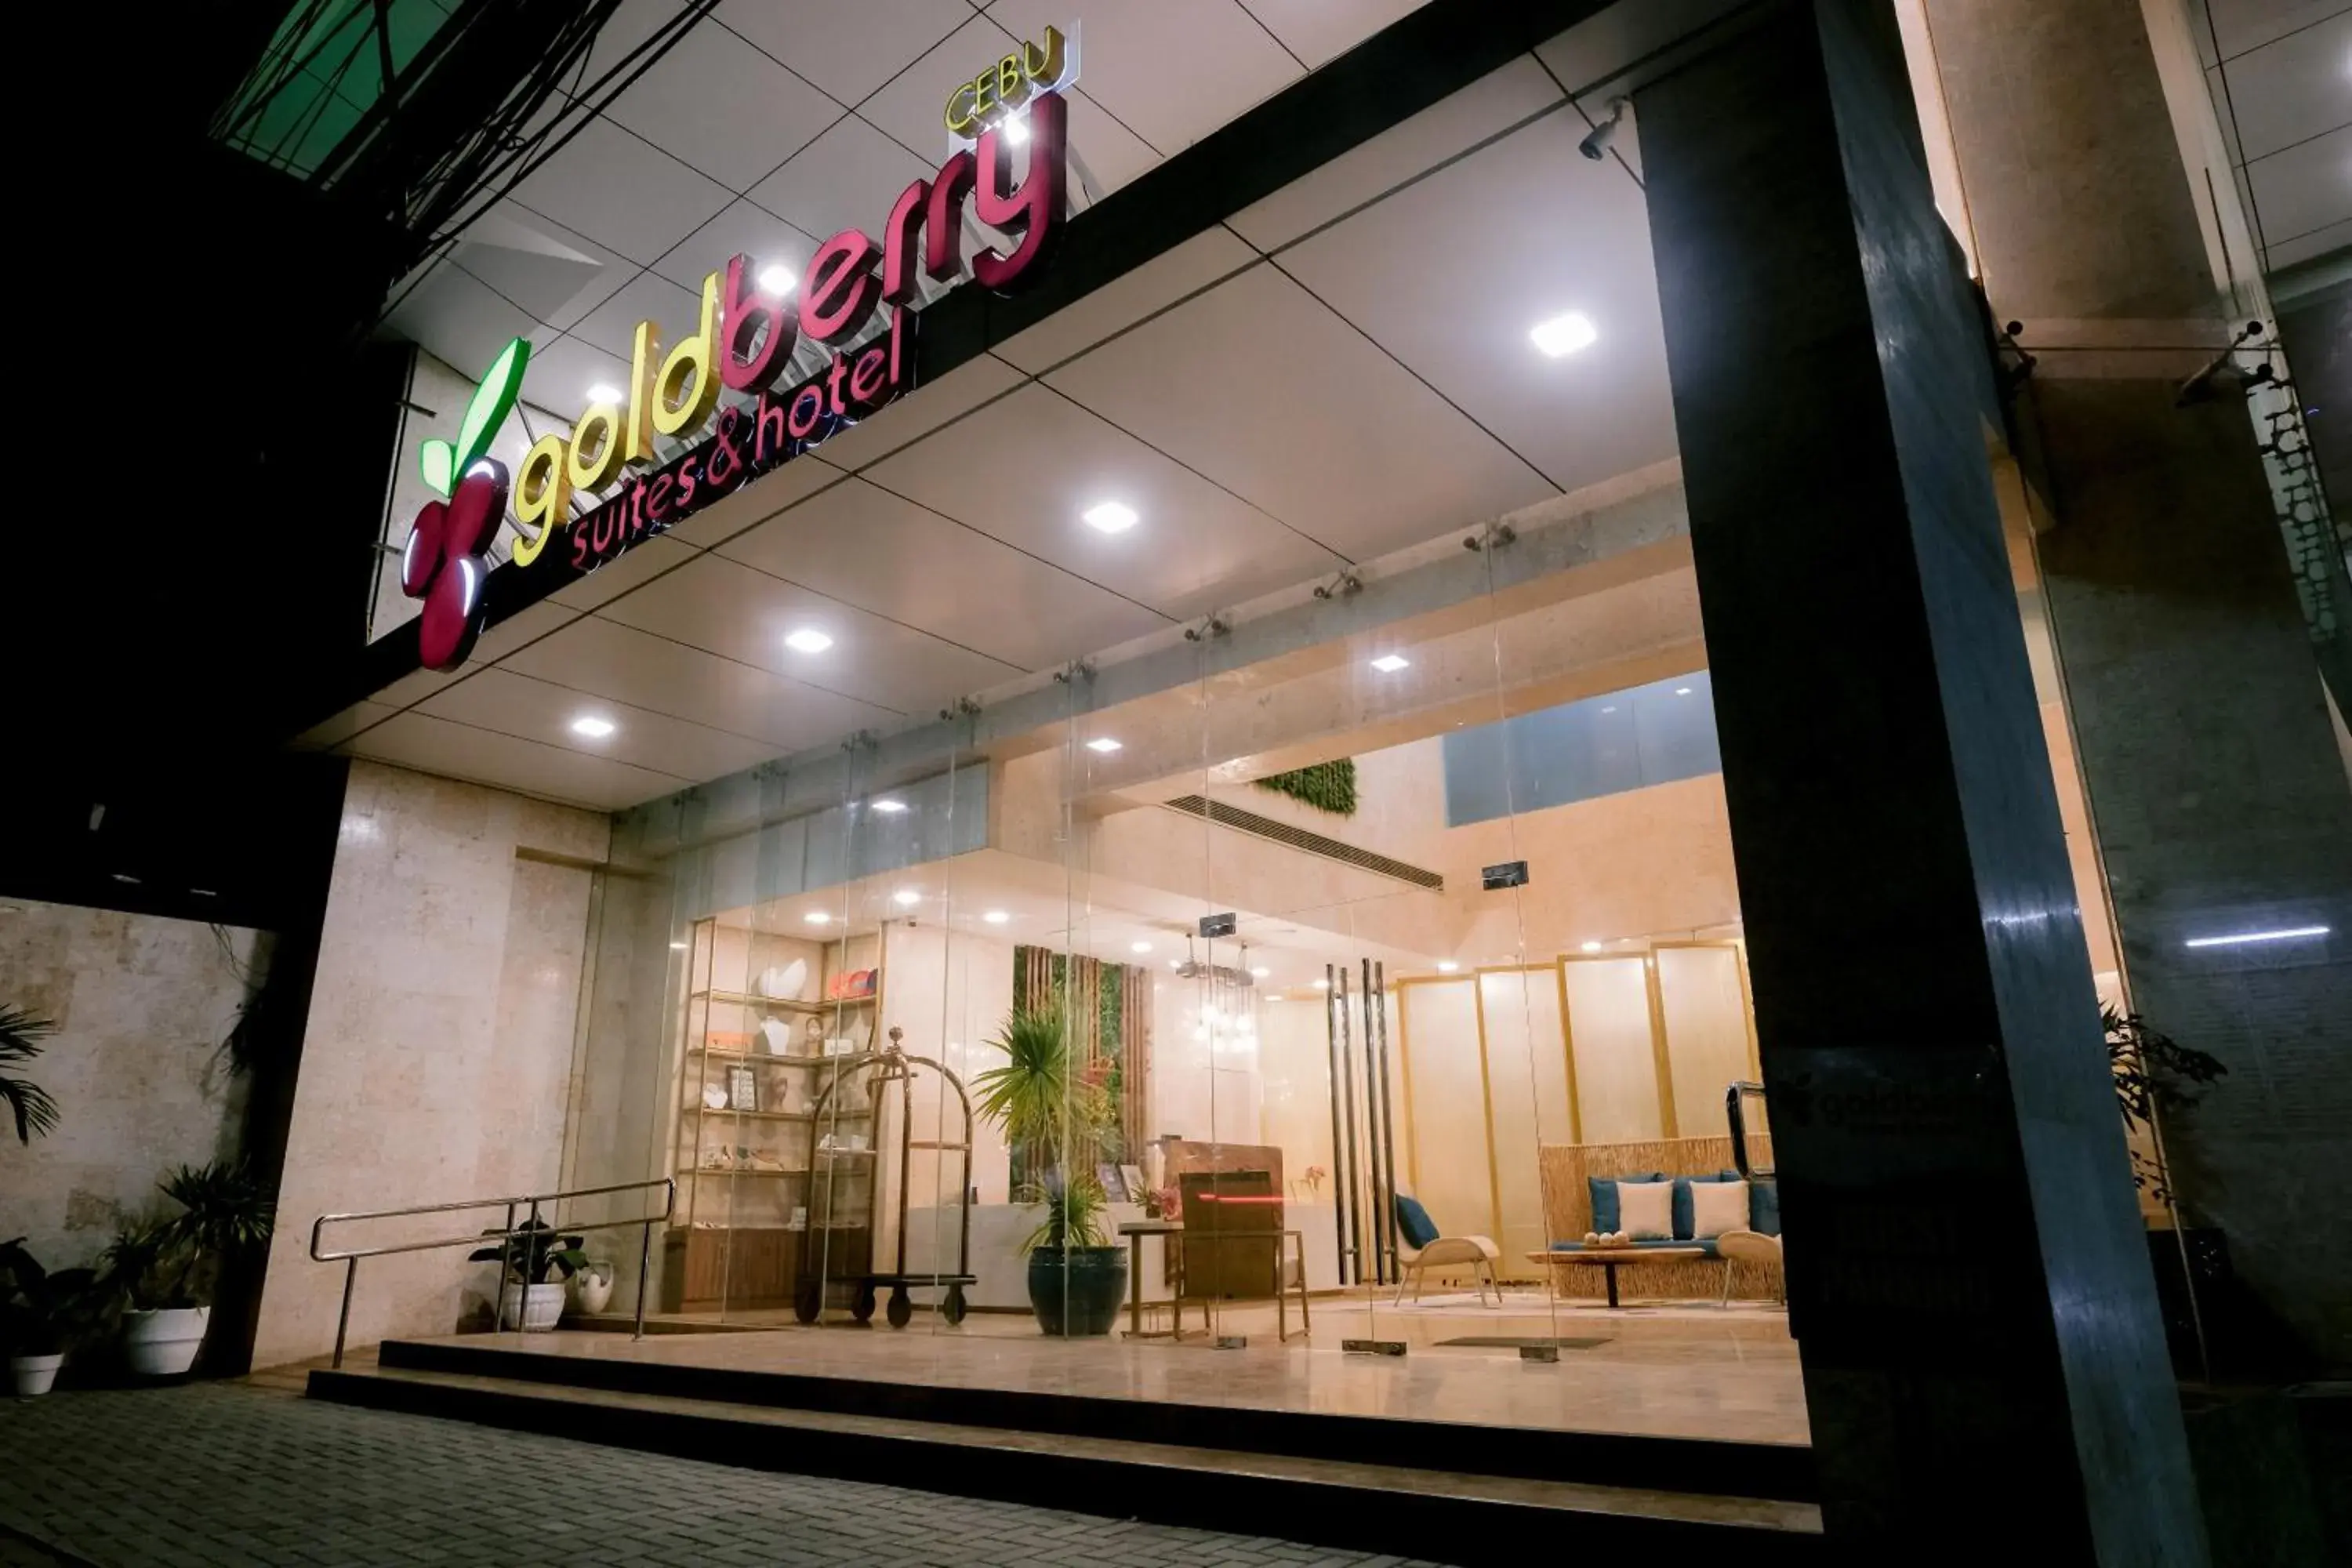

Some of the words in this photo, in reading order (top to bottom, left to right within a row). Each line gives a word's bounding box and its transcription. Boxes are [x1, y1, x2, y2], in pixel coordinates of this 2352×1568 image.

[945, 25, 1064, 137] CEBU
[512, 92, 1067, 567] goldberry
[572, 456, 697, 568] suites
[708, 405, 743, 485] &
[755, 306, 902, 463] hotel
